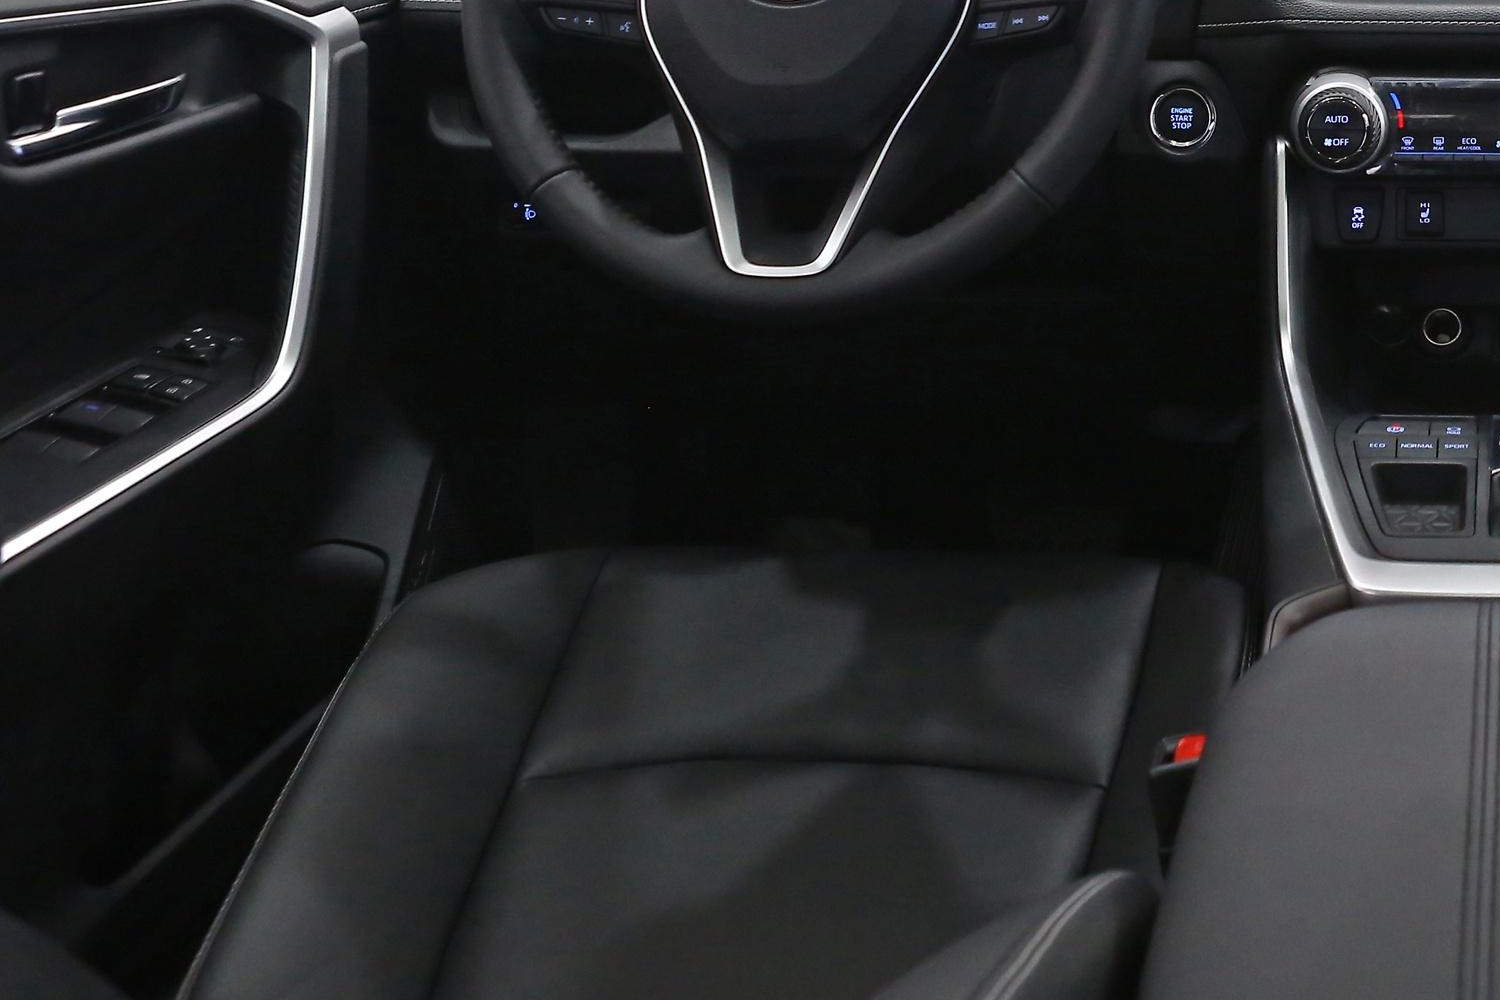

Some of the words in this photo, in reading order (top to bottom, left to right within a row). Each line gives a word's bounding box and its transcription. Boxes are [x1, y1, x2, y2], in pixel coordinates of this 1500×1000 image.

[978, 22, 997, 30] MODE
[1170, 114, 1193, 122] START
[1324, 115, 1349, 124] AUTO
[1332, 138, 1350, 147] OFF
[1461, 137, 1477, 145] ECO
